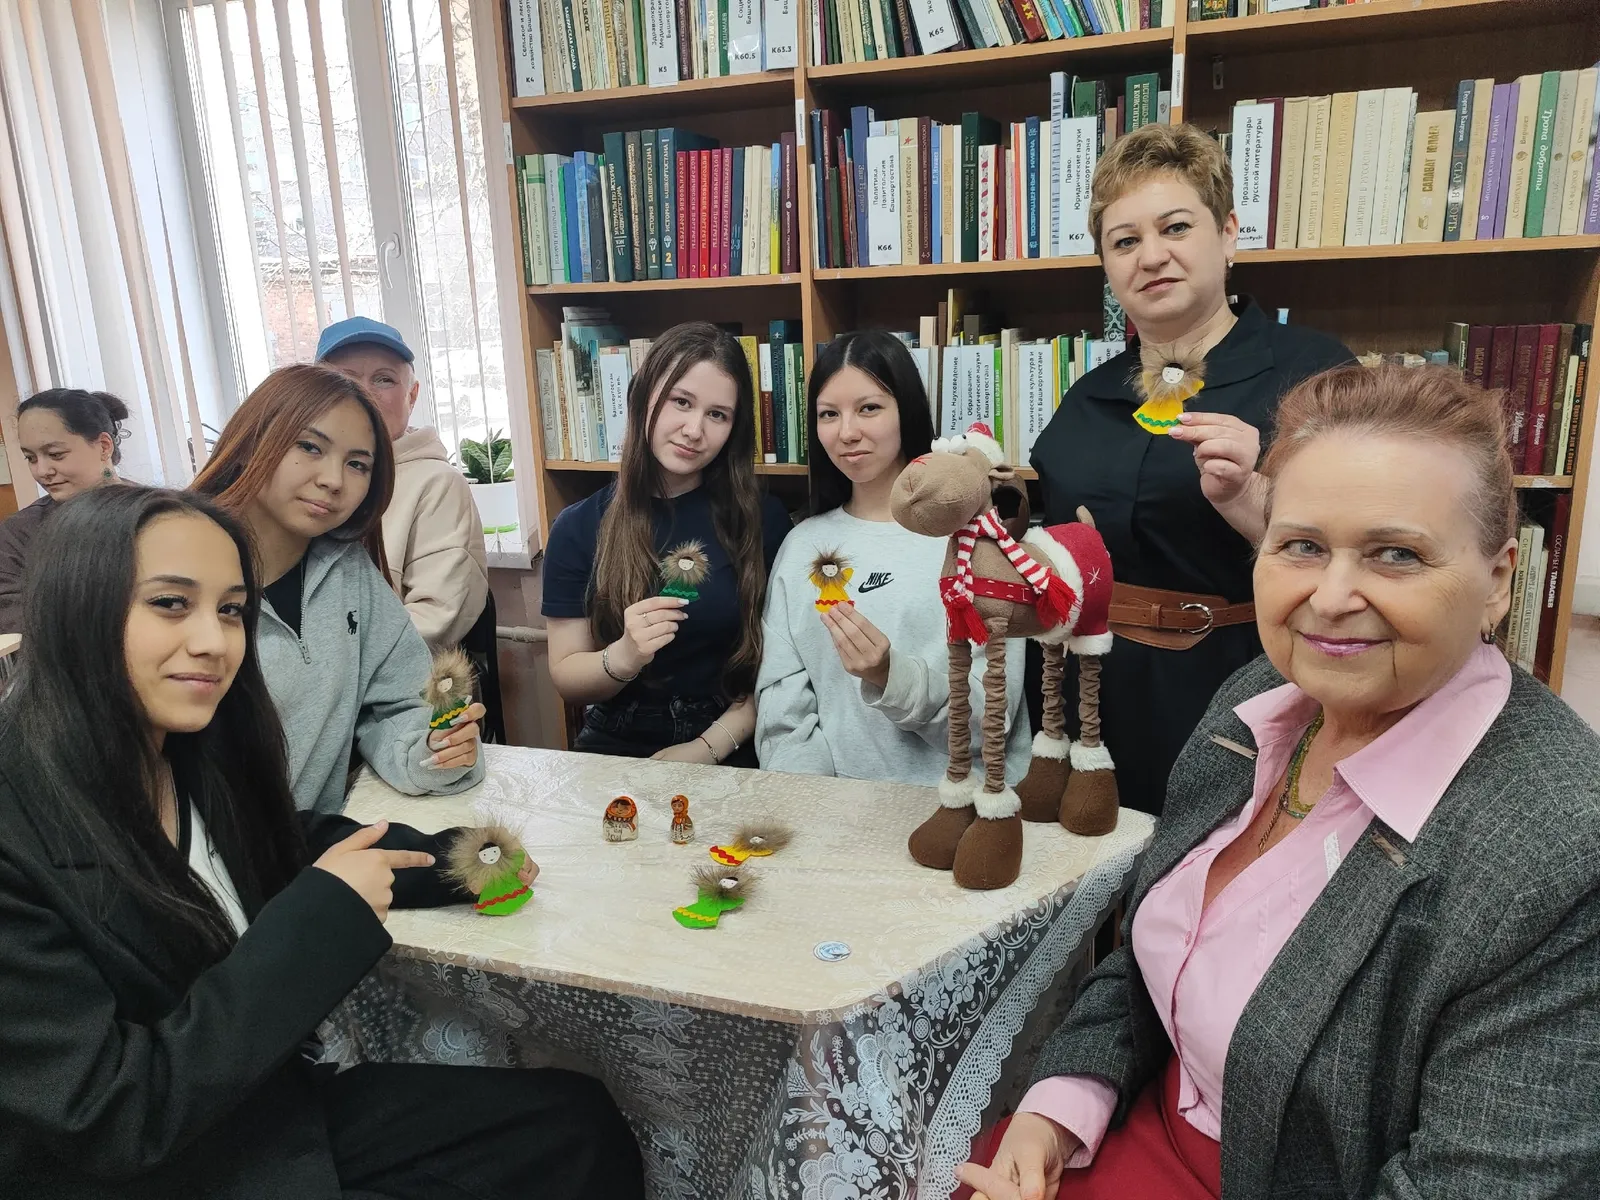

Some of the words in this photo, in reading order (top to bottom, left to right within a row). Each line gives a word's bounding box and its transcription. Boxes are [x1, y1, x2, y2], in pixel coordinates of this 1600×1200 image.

[520, 24, 528, 57] Сельское
[929, 26, 944, 38] К65
[1244, 116, 1252, 146] жанры
[1426, 126, 1440, 153] ЮЛАЕВ
[1541, 108, 1553, 140] Тропа
[1254, 118, 1262, 168] литературы
[646, 147, 654, 202] БАШКОРТОСТАНА
[1074, 154, 1082, 210] Юридические
[1241, 147, 1251, 206] Прозаические
[1311, 155, 1321, 187] РУССКОЙ
[1422, 158, 1436, 192] САЛАВАТ
[1536, 144, 1550, 191] доброты
[1252, 170, 1260, 203] русской
[1354, 195, 1366, 237] БАШКИРИЯ
[1362, 150, 1371, 184] РУССКОЙ
[1306, 200, 1317, 241] БАШКИРИЯ
[1590, 202, 1598, 222] ПЕТР
[1239, 226, 1256, 234] К84
[666, 252, 672, 262] 2
[702, 264, 706, 272] 3
[712, 264, 718, 272] 4
[951, 356, 959, 406] Науковедение
[866, 572, 892, 586] NIKE
